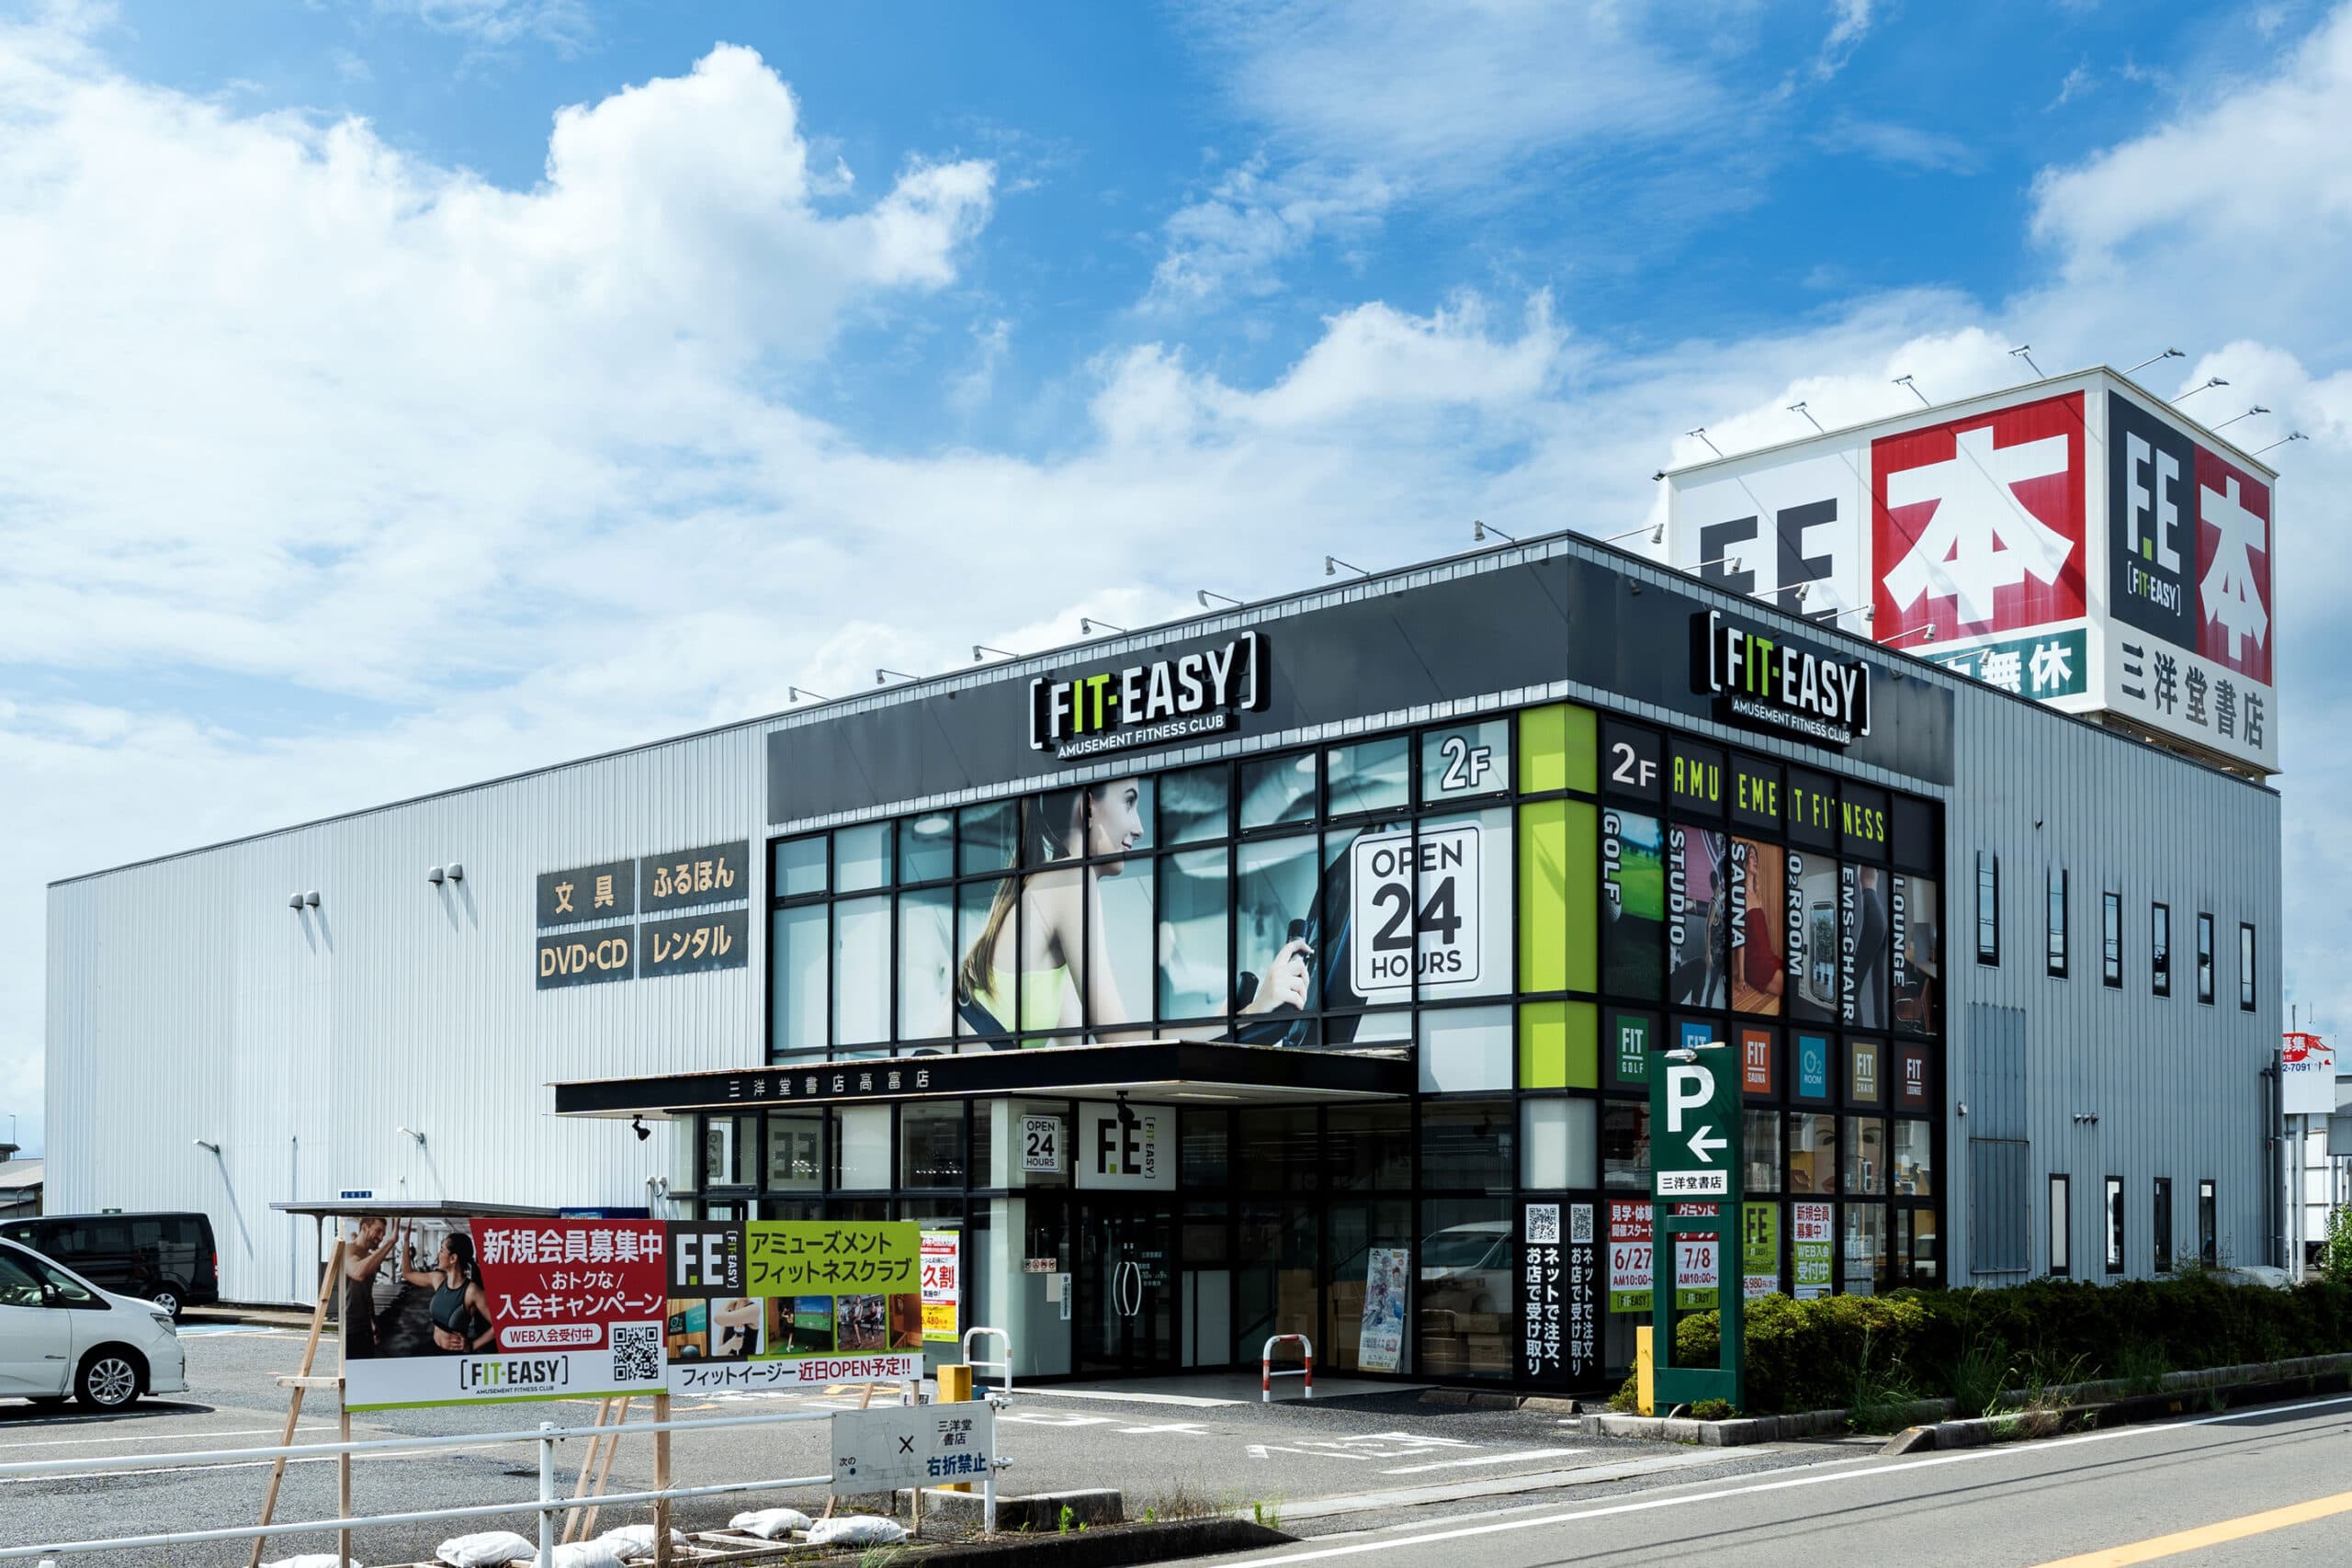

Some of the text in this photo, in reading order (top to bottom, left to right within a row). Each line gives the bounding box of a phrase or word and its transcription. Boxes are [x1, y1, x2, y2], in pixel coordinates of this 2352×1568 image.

[1883, 425, 2075, 624] 本
[2199, 475, 2268, 661] 本
[1947, 641, 2073, 694] 無休
[2121, 642, 2265, 750] 三洋堂書店
[1733, 699, 1850, 744] AMUSEMENT FITNESS CLUB
[1057, 715, 1224, 759] AMUSEMENT FITNESS CLUB
[1441, 736, 1490, 792] 2F
[1611, 742, 1657, 786] 2F
[1674, 756, 1802, 822] AMUEMET
[1372, 840, 1463, 878] OPEN
[1603, 814, 1621, 903] GOLF
[653, 857, 734, 897] ふるほん
[1669, 829, 1685, 944] STUDIO
[1731, 843, 1746, 948] SAUNA
[1372, 875, 1462, 952] 24
[653, 925, 732, 963] レンタル
[1842, 867, 1855, 1021] EMS-CHAIR
[1893, 876, 1905, 987] LOUNGE
[1372, 950, 1463, 979] HOURS
[1622, 1027, 1644, 1054] FIT
[1747, 1040, 1766, 1066] FIT
[1622, 1061, 1644, 1074] GOLF
[1747, 1072, 1766, 1084] SAUNA
[1857, 1053, 1873, 1076] FIT
[1906, 1057, 1922, 1079] FIT
[1804, 1074, 1822, 1085] ROOM
[1667, 1066, 1715, 1132] P
[1026, 1120, 1056, 1132] OPEN
[1026, 1133, 1055, 1156] 24
[1026, 1157, 1055, 1167] HOURS
[1662, 1176, 1723, 1190] 三洋堂書店
[1796, 1205, 1829, 1222] 新規会員
[483, 1229, 663, 1264] 新規会員募集中
[751, 1230, 892, 1255] アミューズメント
[751, 1258, 911, 1284] フィットネスクラブ
[1614, 1248, 1652, 1270] 6/27
[1684, 1248, 1711, 1269] 7/8
[1797, 1260, 1829, 1280] 受付中
[921, 1264, 955, 1289] 久割
[496, 1292, 663, 1320] 入会キャンペーン
[1526, 1247, 1542, 1376] お店で受け取り
[1570, 1247, 1582, 1376] お店で受け取り
[509, 1328, 594, 1343] WEB入会受付中
[682, 1362, 796, 1386] フィットイージー
[476, 1386, 513, 1394] AMUSEMENT
[937, 1418, 972, 1433] 三洋堂
[944, 1433, 967, 1446] 書店
[839, 1456, 856, 1467] 次の
[927, 1452, 987, 1477] 右折禁止
